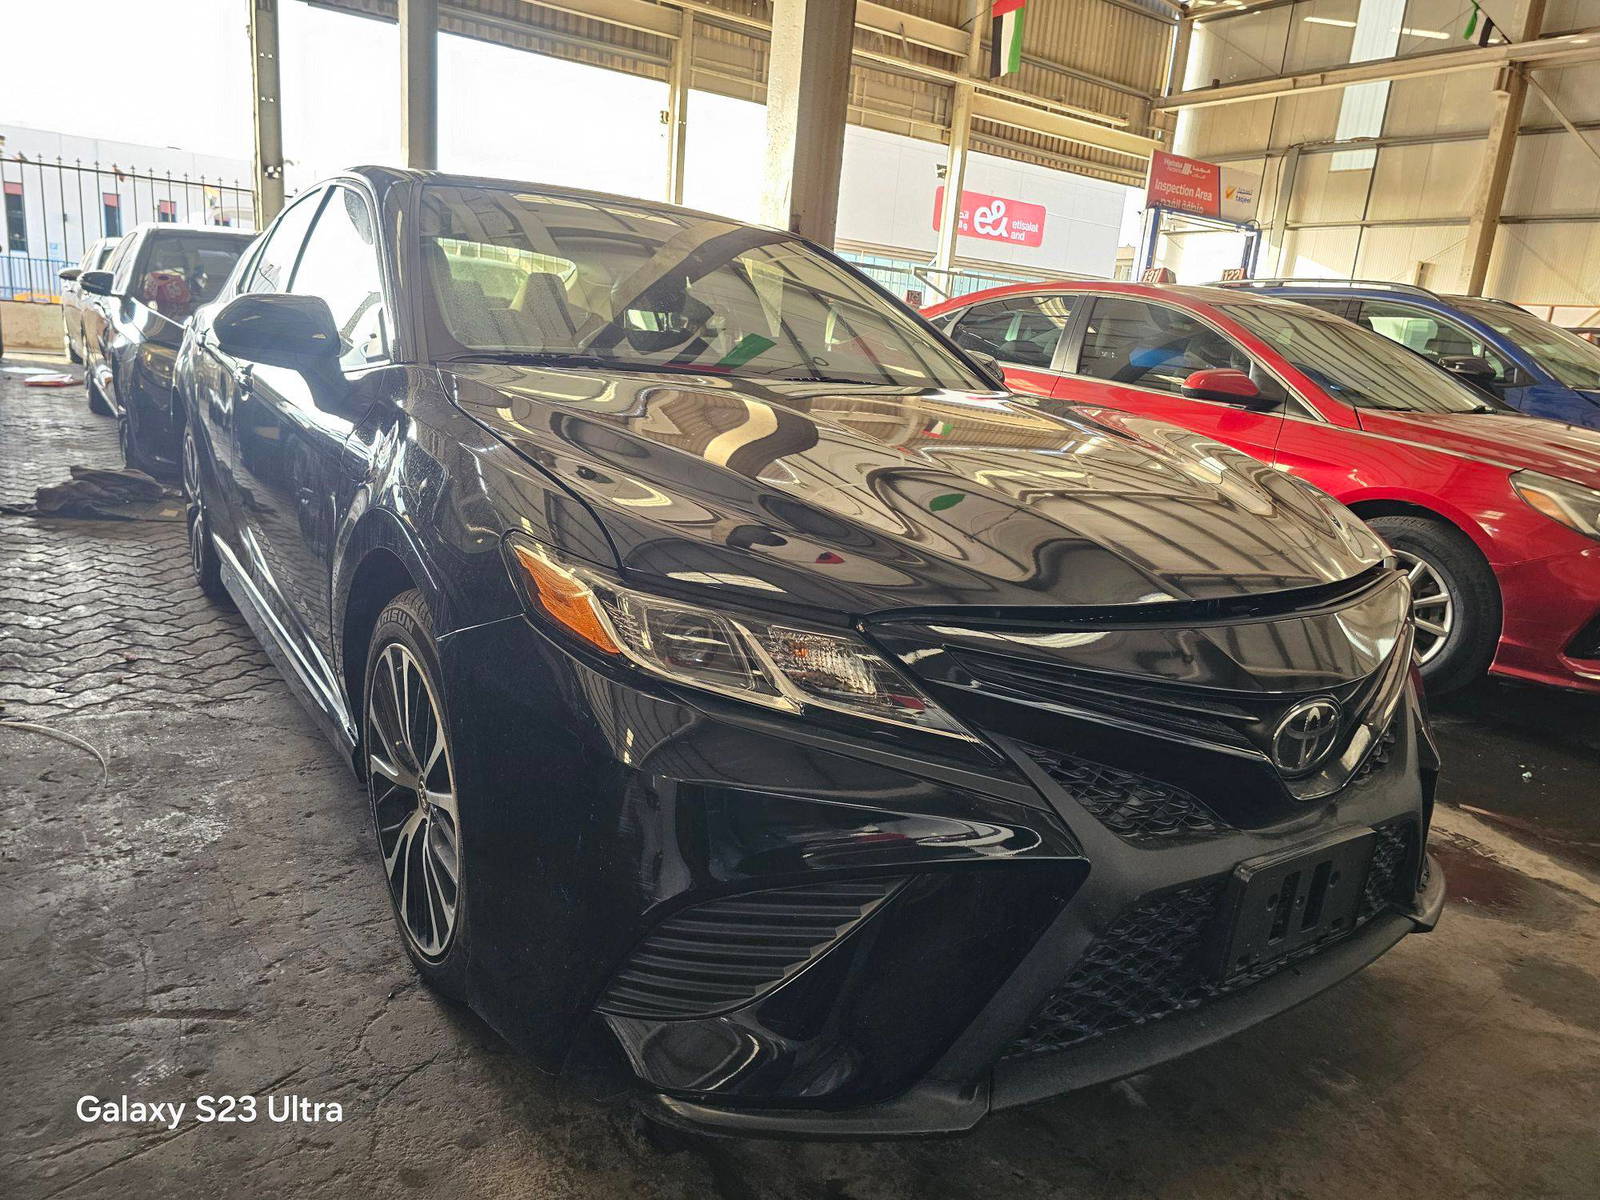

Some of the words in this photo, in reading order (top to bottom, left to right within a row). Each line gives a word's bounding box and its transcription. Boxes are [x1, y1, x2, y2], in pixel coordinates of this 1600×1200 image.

[1154, 178, 1194, 197] Inspection
[1195, 187, 1213, 201] Area
[1011, 219, 1039, 233] etisalat
[1010, 230, 1025, 241] and
[1224, 269, 1240, 281] 122
